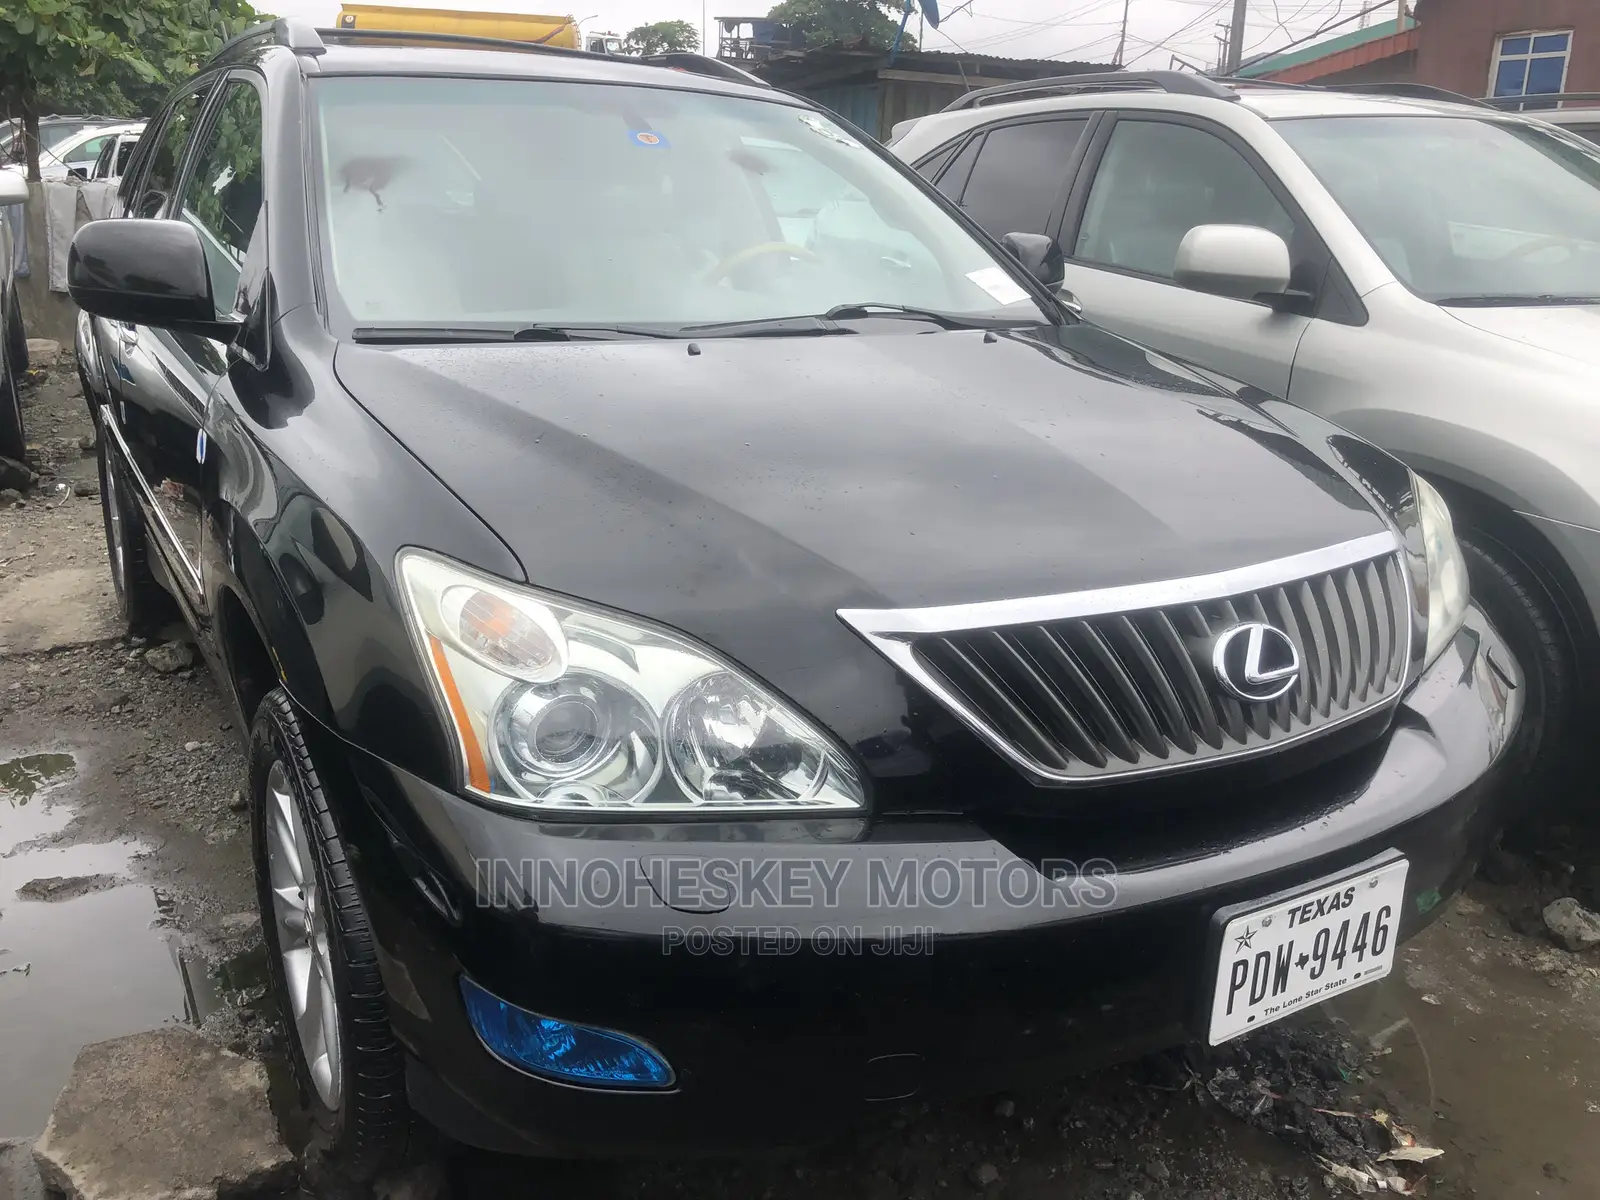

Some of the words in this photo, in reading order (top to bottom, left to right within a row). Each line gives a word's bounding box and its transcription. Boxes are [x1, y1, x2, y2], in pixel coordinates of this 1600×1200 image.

[1287, 886, 1356, 929] TEXAS
[1225, 939, 1295, 1016] PDW
[1309, 905, 1392, 980] 9446
[1263, 1004, 1281, 1016] The
[1282, 995, 1303, 1009] Lone
[1305, 986, 1322, 999] Star
[1324, 977, 1347, 992] State
